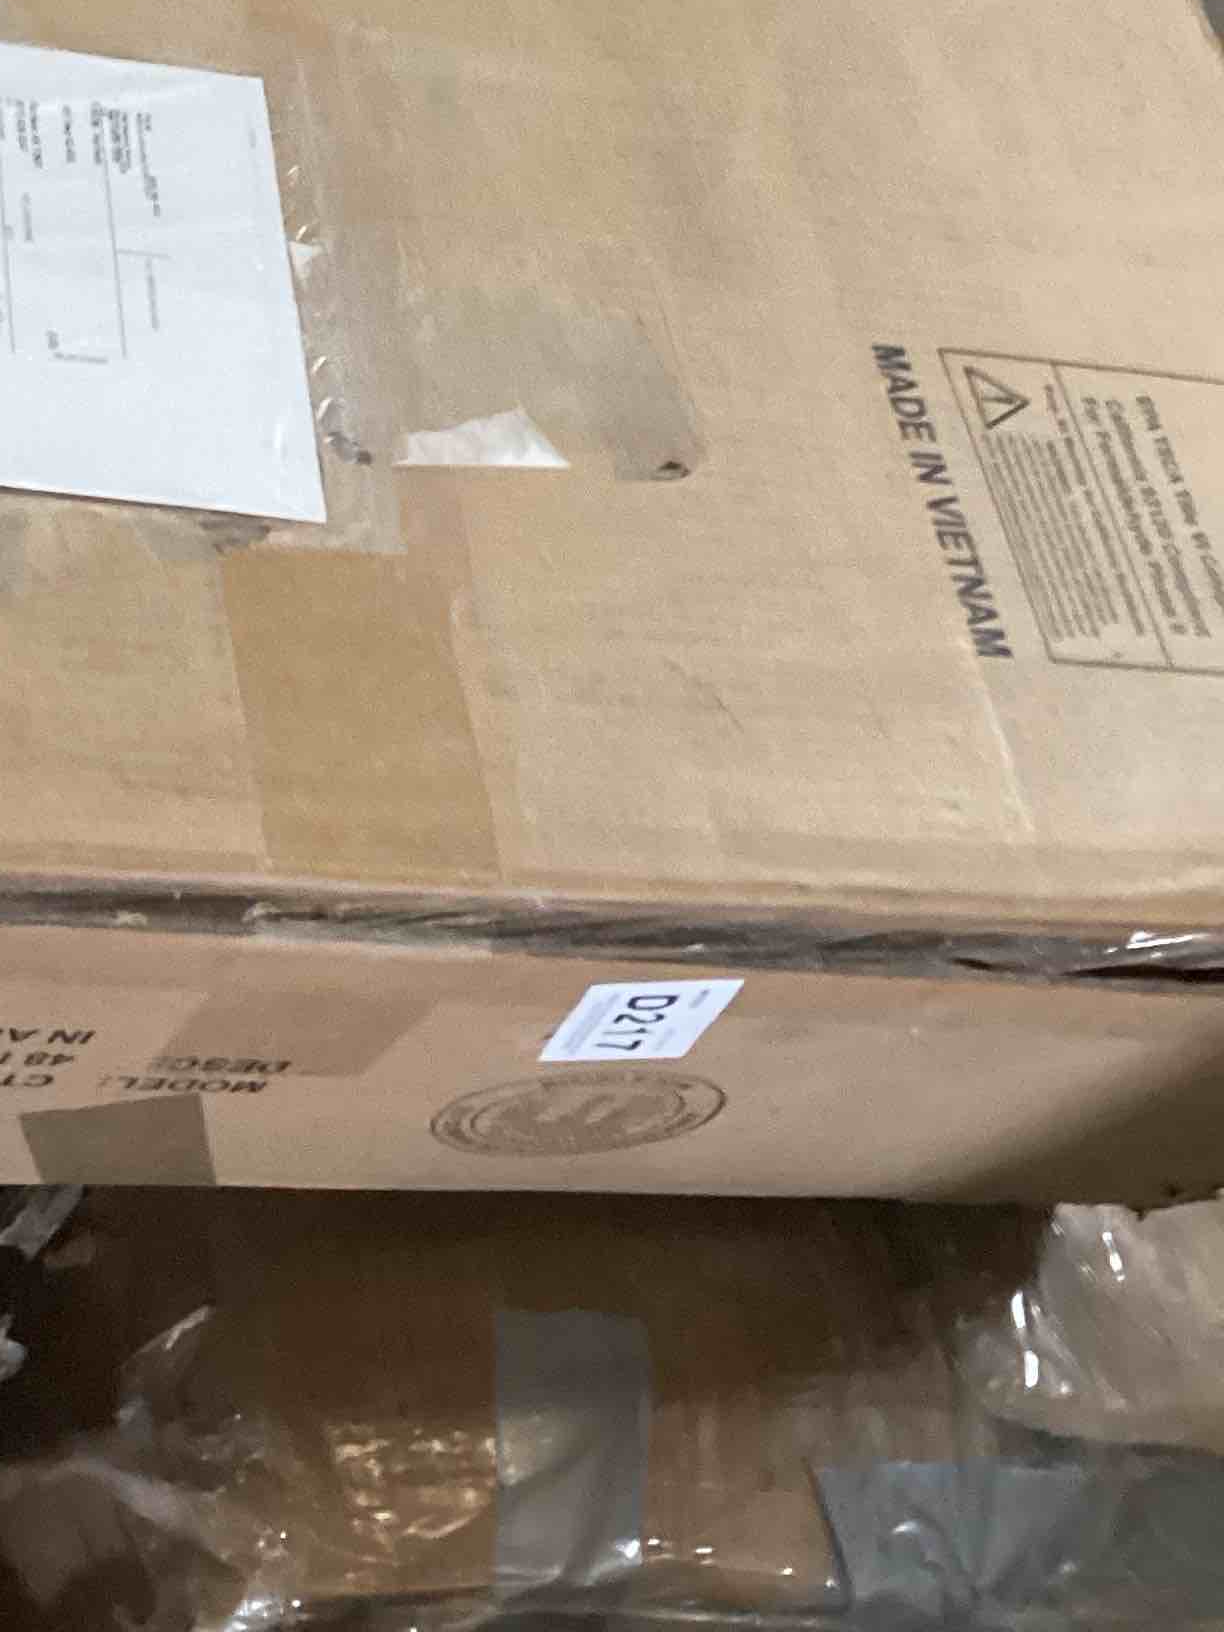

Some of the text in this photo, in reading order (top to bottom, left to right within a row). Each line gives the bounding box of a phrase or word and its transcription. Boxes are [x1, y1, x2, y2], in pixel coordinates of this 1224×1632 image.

[872, 344, 1014, 659] MADE IN VIETNAM
[595, 994, 680, 1051] D217
[47, 1029, 97, 1045] IN
[26, 1051, 75, 1067] 48
[95, 1075, 268, 1093] MODEL:
